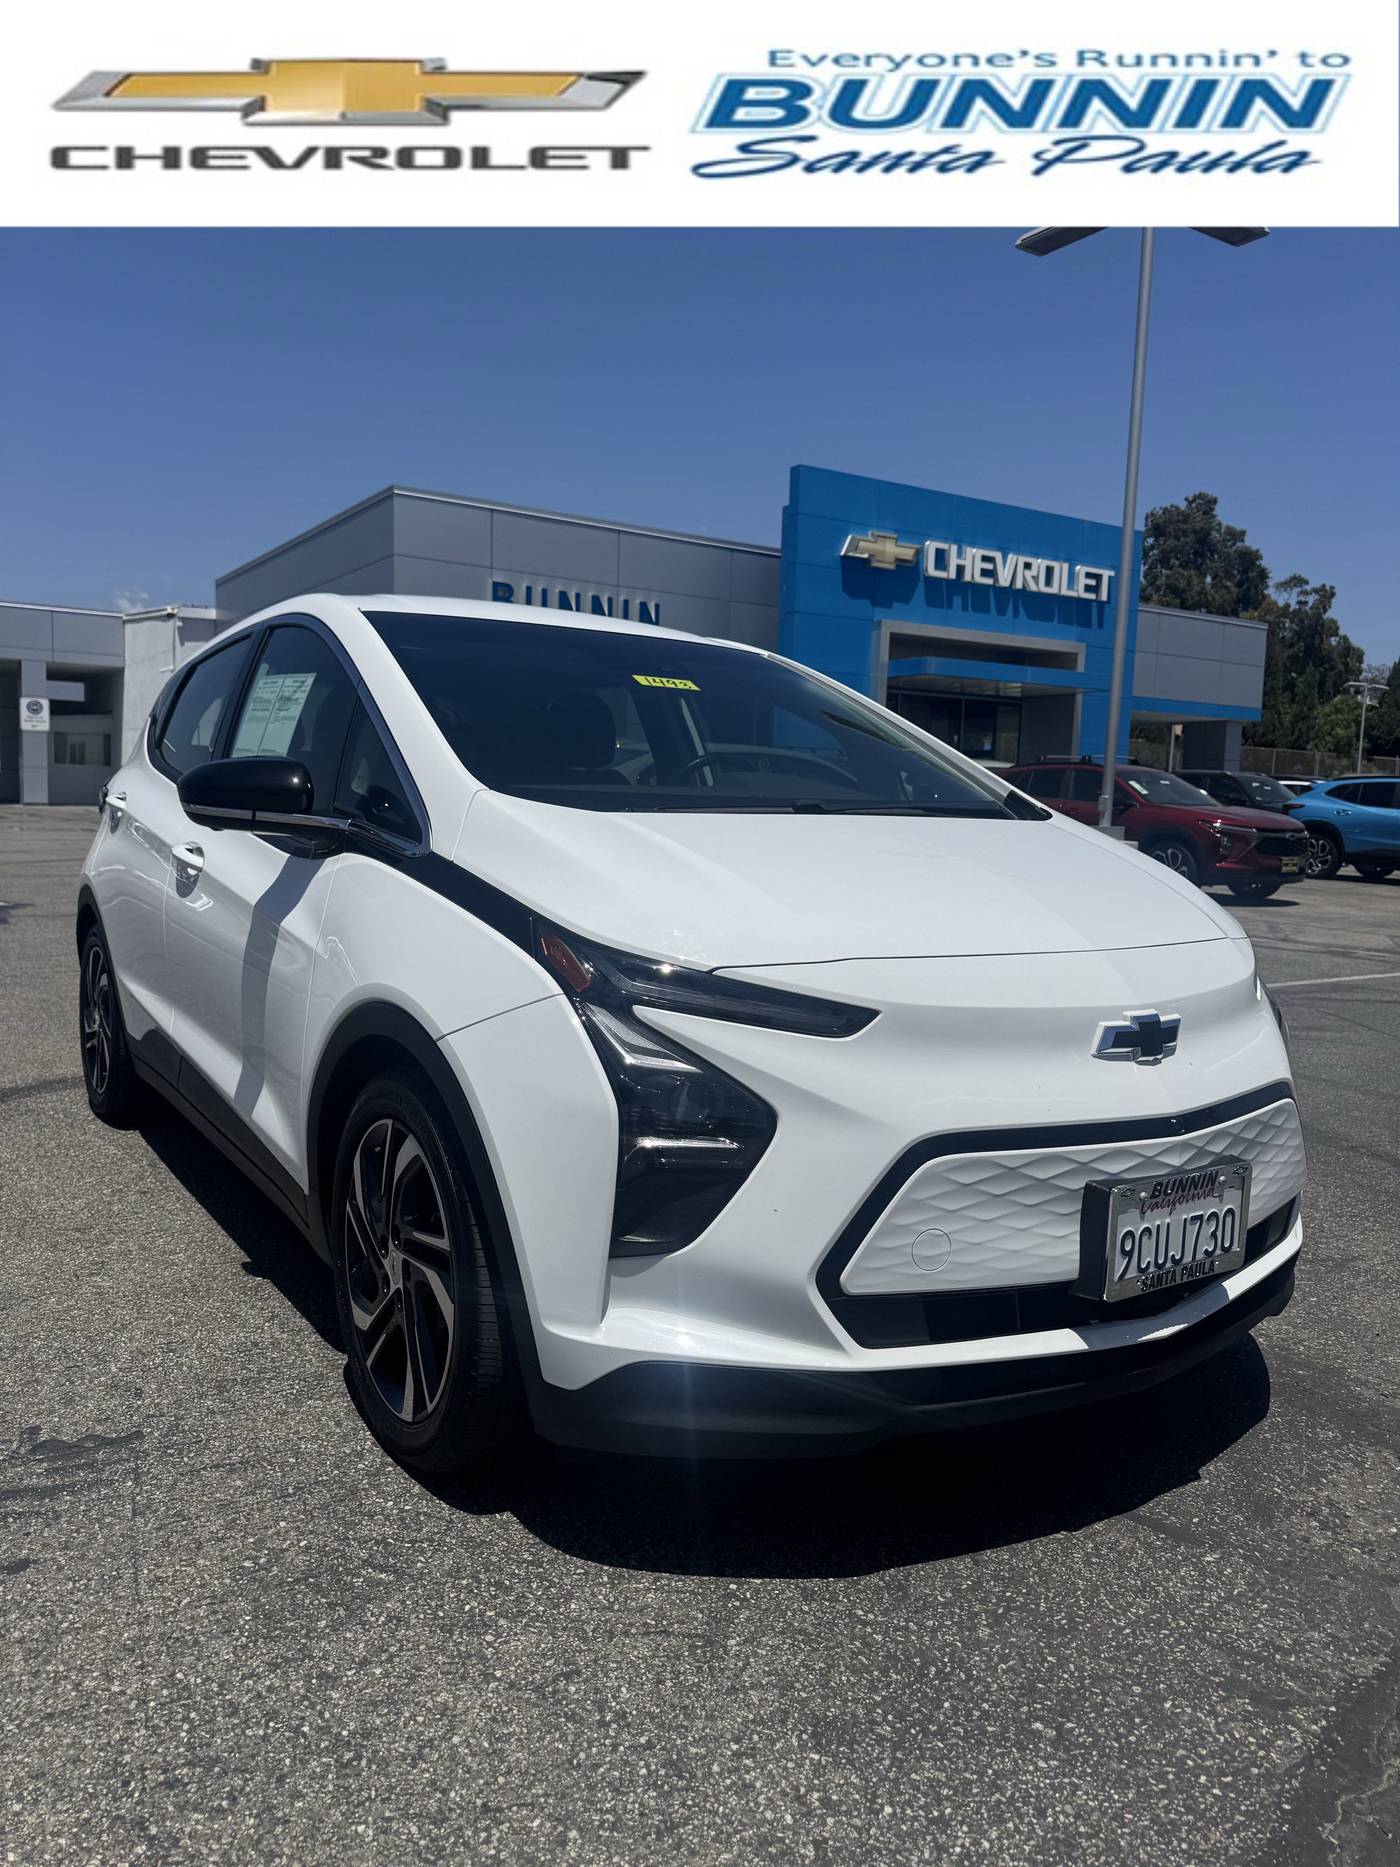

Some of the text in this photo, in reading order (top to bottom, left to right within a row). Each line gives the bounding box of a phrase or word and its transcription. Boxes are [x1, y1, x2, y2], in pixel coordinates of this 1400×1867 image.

[924, 540, 1115, 602] CHEVROLET
[1150, 1170, 1219, 1199] BUNNIN
[1117, 1207, 1236, 1281] 9CUJ730
[1141, 1261, 1216, 1292] SANTA PAULA
